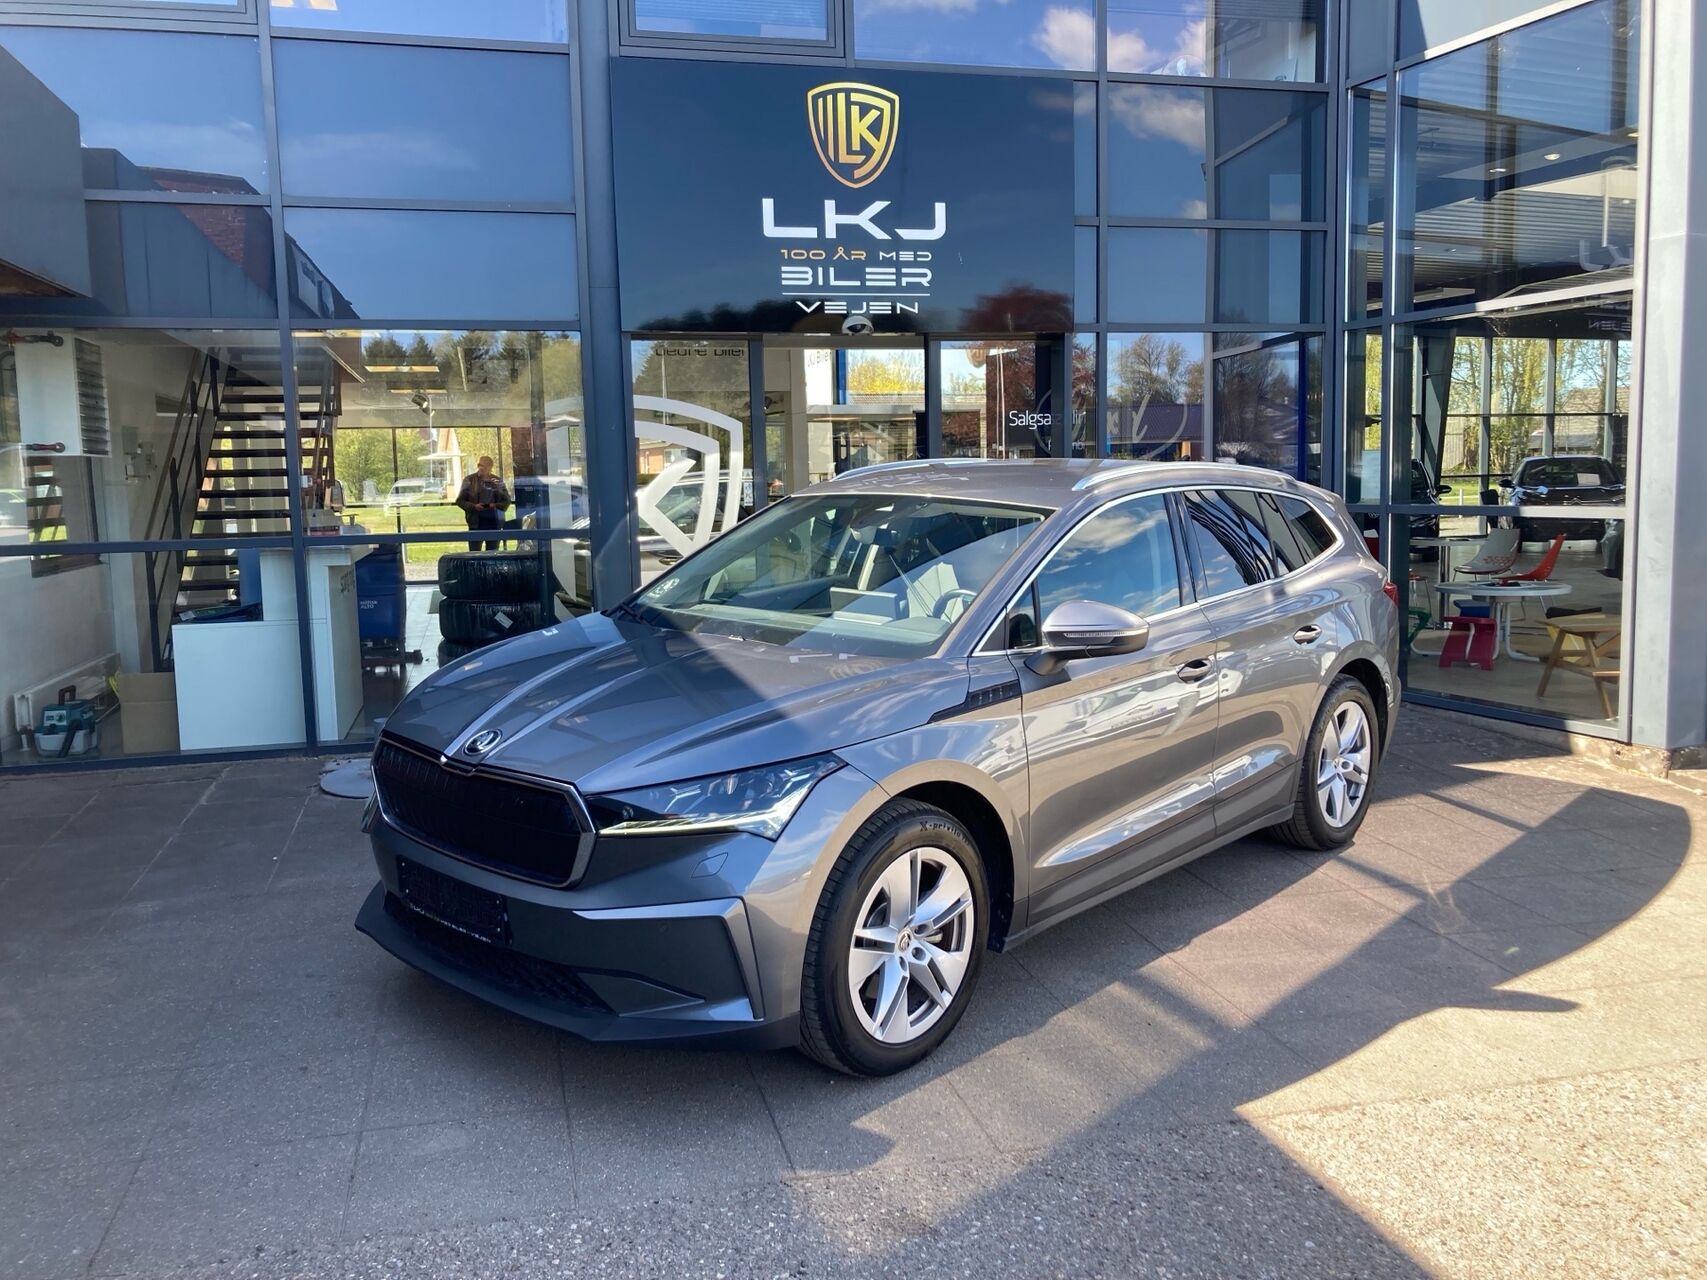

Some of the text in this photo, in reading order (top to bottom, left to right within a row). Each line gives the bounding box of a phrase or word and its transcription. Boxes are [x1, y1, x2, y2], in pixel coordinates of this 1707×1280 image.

[762, 198, 947, 240] LKJ
[781, 249, 826, 260] 100
[879, 251, 933, 261] MED
[781, 266, 933, 287] BILER
[796, 300, 919, 314] VEJEN
